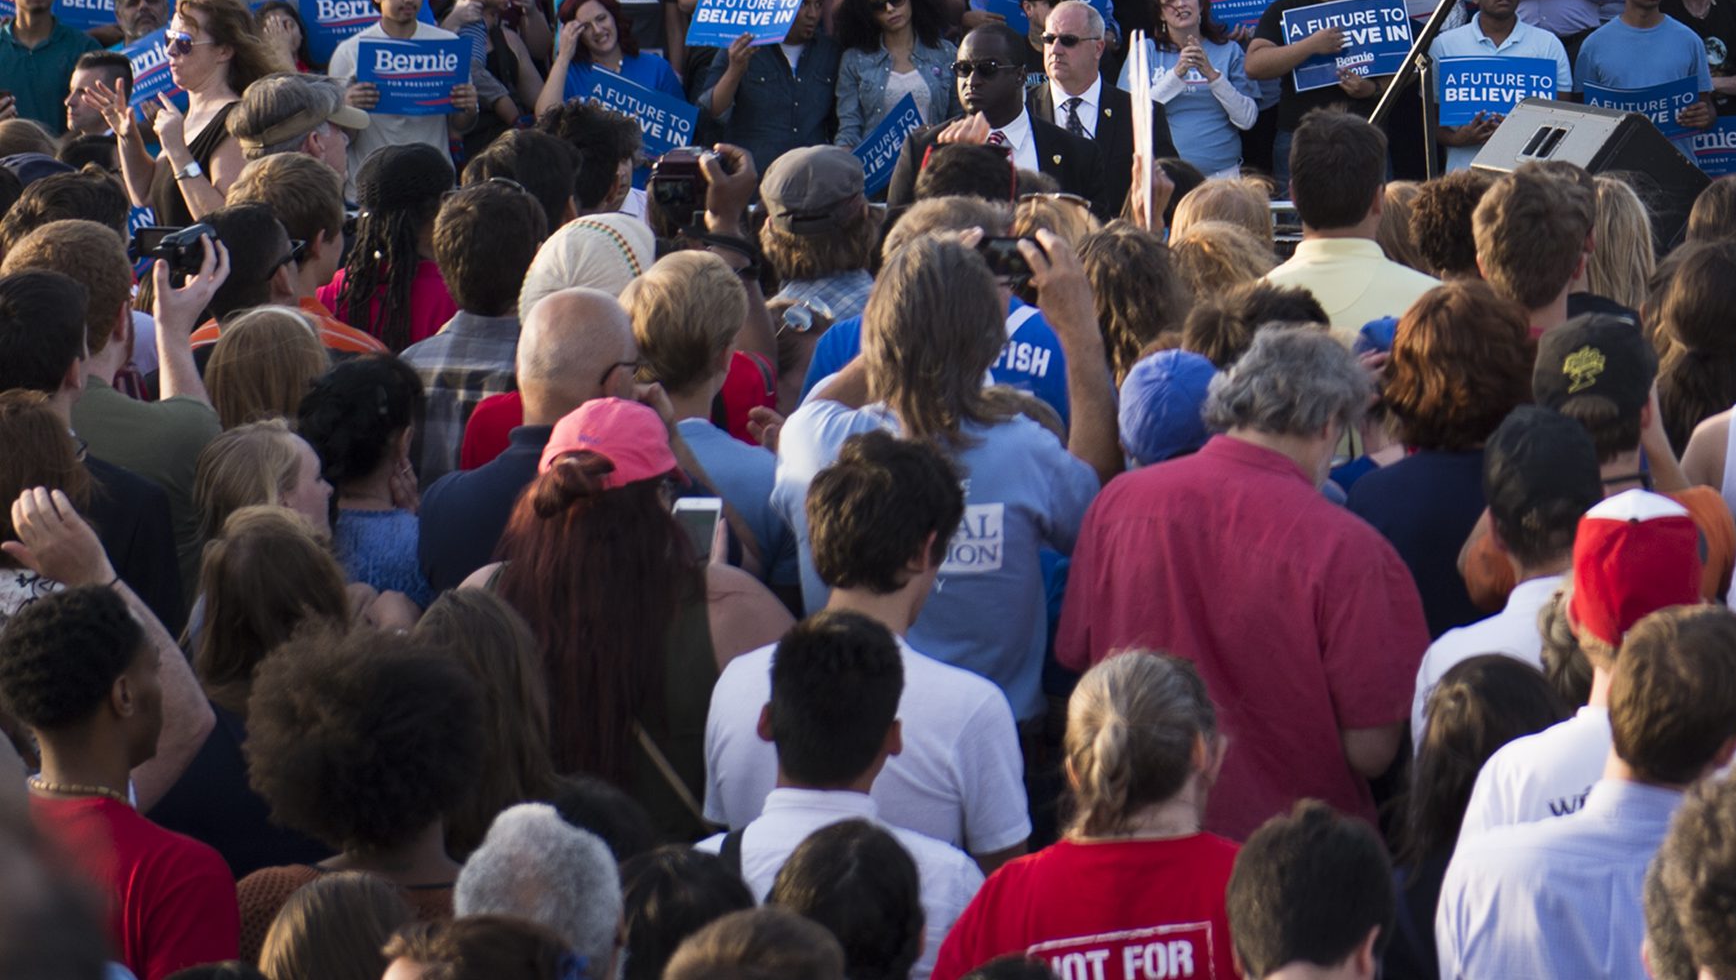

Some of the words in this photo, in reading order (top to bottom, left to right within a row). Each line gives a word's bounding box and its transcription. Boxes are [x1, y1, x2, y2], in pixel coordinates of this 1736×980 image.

[1228, 0, 1266, 8] PRESIDENT
[697, 9, 770, 25] BELIEVE
[773, 8, 793, 24] IN
[1290, 22, 1303, 37] A
[1308, 14, 1377, 36] FUTURE
[1380, 8, 1405, 23] TO
[1386, 25, 1409, 42] IN
[375, 50, 457, 72] Bernie
[1336, 52, 1374, 68] Bernie
[1446, 73, 1457, 85] A
[1461, 73, 1525, 87] FUTURE
[1529, 75, 1552, 88] TO
[1445, 88, 1523, 103] BELIEVE
[1589, 96, 1600, 108] A
[1604, 96, 1667, 110] FUTURE
[1670, 92, 1694, 105] TO
[593, 83, 604, 95] A
[604, 88, 660, 120] FUTURE
[664, 116, 690, 132] TO
[666, 129, 688, 146] IN
[1123, 940, 1195, 979] FOR
